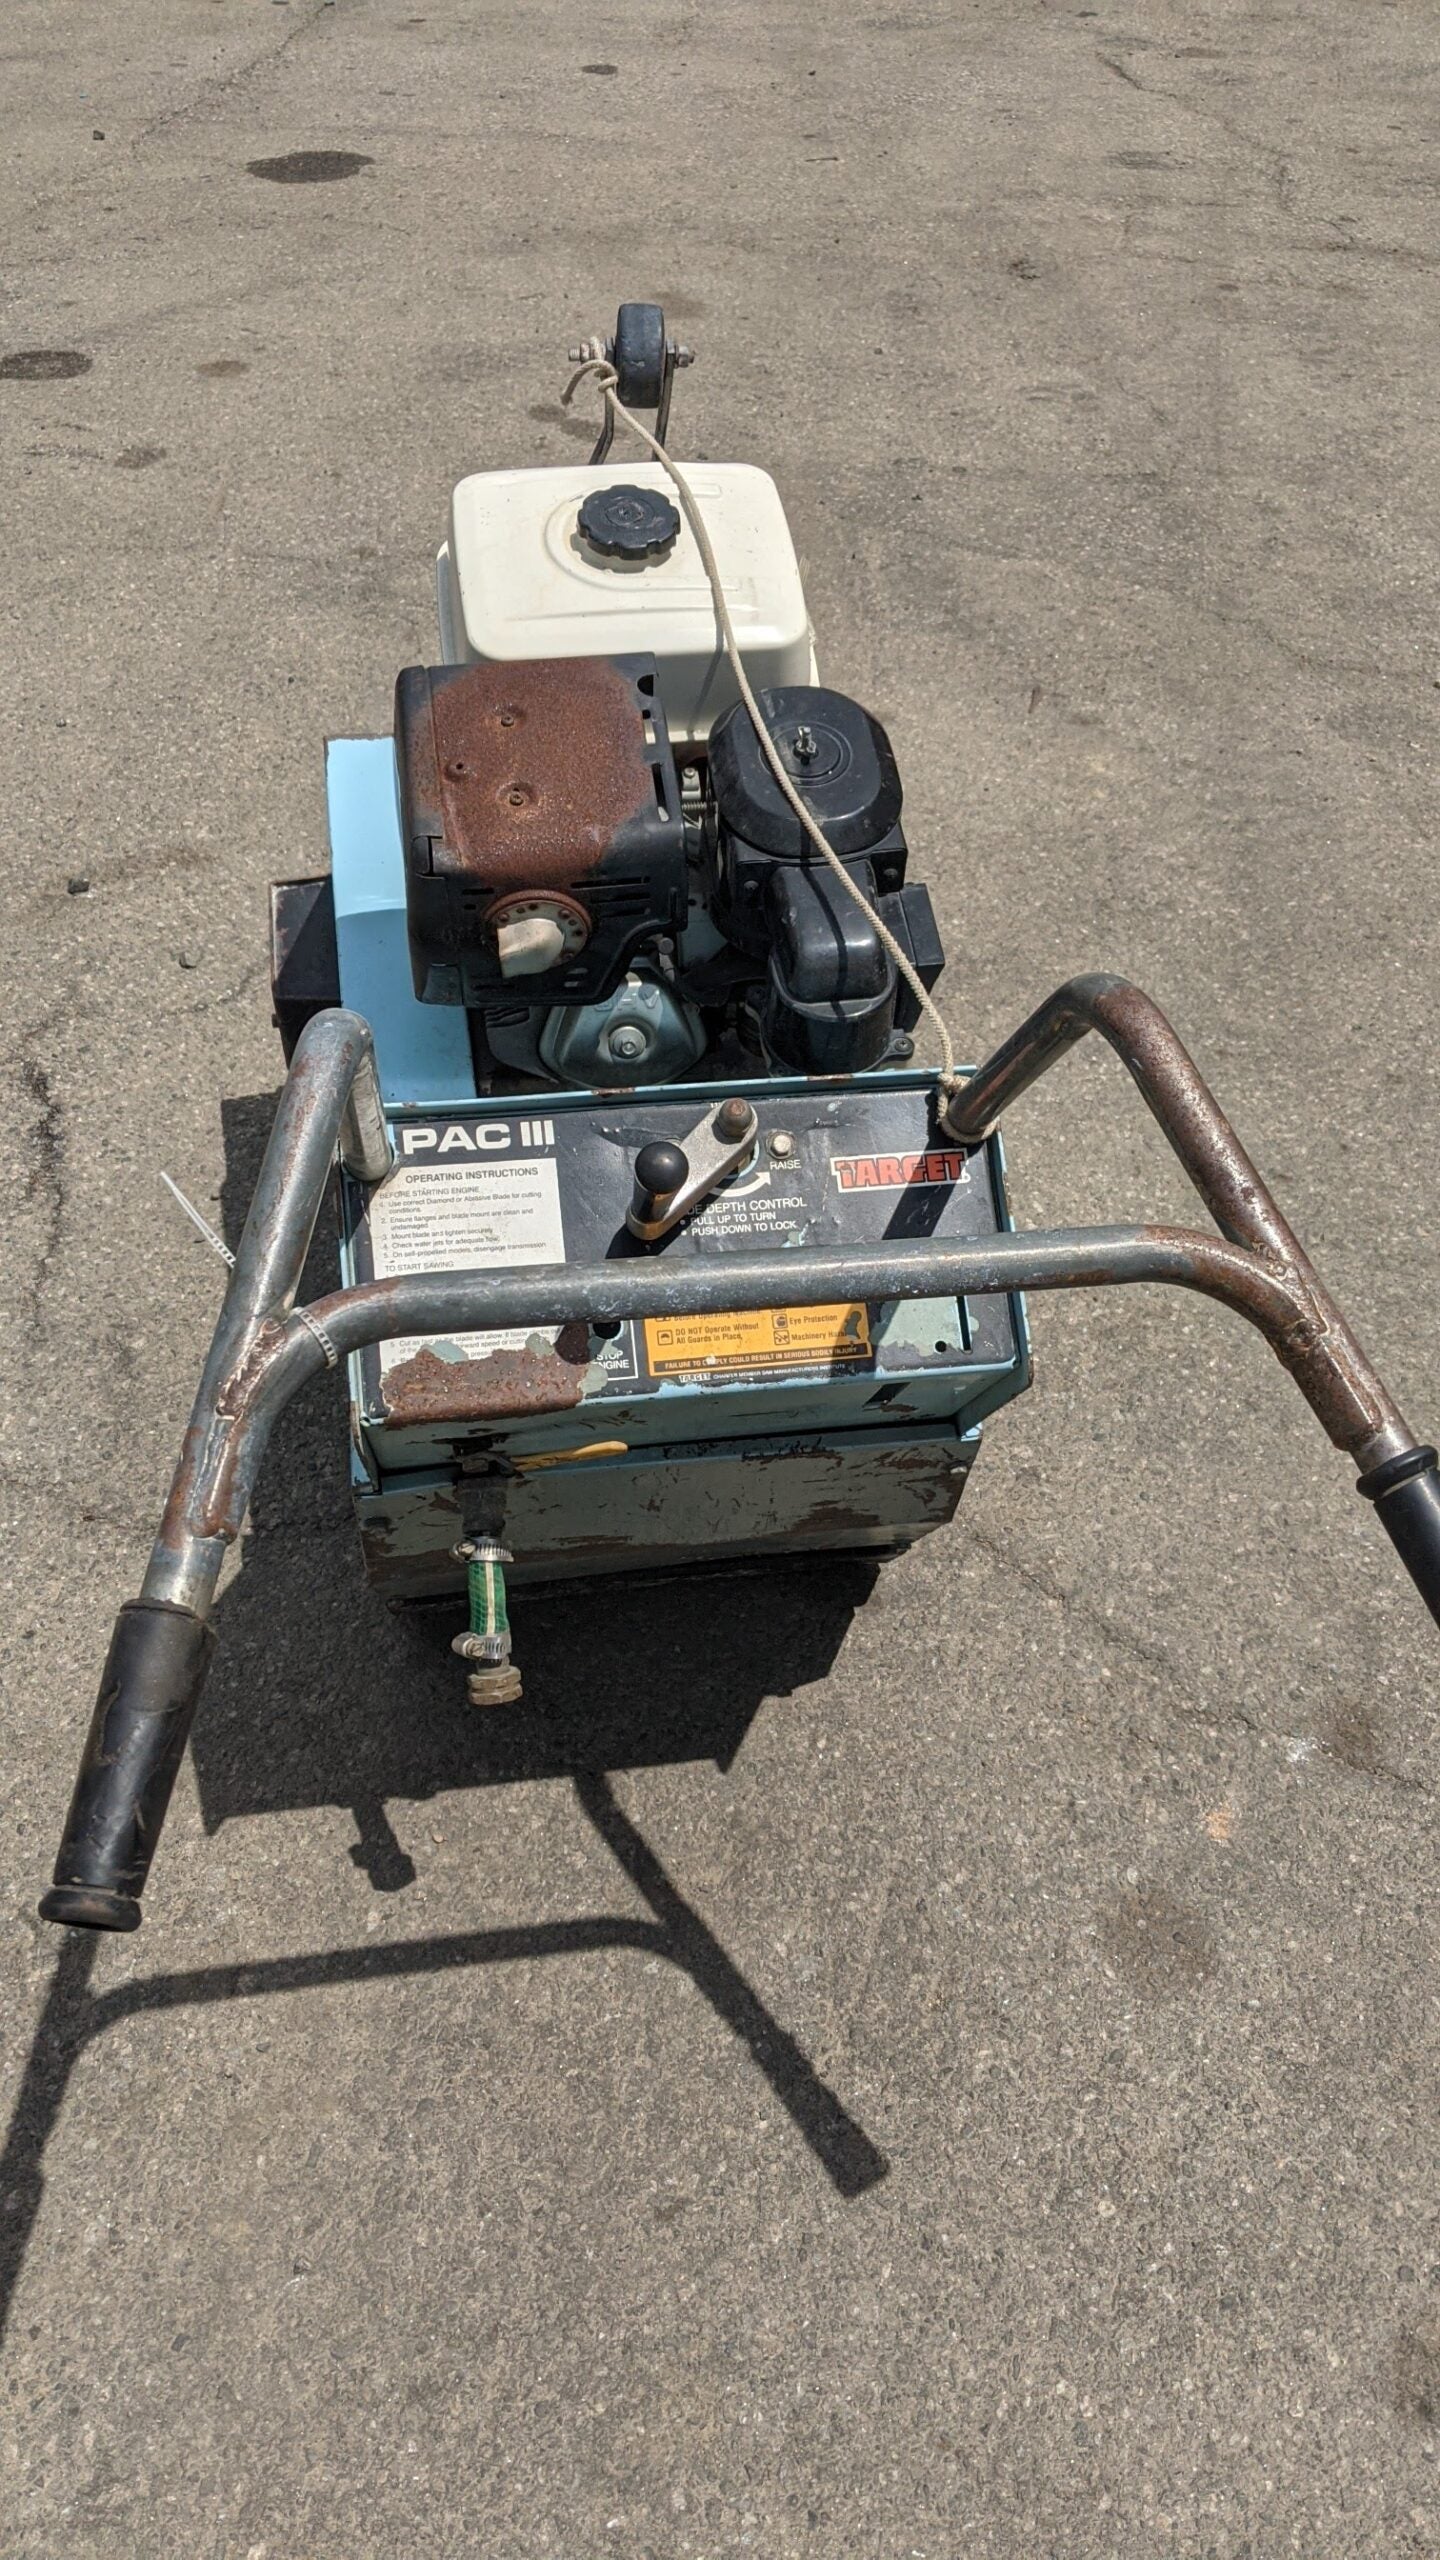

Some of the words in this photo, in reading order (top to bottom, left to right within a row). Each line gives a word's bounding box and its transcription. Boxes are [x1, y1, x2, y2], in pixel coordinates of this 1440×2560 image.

[402, 1123, 511, 1155] PAC
[519, 1120, 555, 1147] III
[770, 1160, 801, 1170] RAISE
[836, 1152, 964, 1188] TARGET
[405, 1170, 463, 1184] OPERATING
[465, 1167, 539, 1180] INSTRUCTIONS
[380, 1190, 410, 1199] BEFORE
[412, 1188, 449, 1197] STARTING
[451, 1186, 480, 1194] ENGINE
[706, 1201, 746, 1214] DEPTH
[749, 1197, 807, 1211] CONTROL
[691, 1216, 716, 1225] PULL
[717, 1215, 731, 1224] UP
[734, 1214, 747, 1222] TO
[750, 1212, 776, 1221] TURN
[692, 1227, 719, 1236] PUSH
[721, 1224, 752, 1234] DOWN
[754, 1222, 767, 1232] TO
[771, 1220, 797, 1230] LOCK
[433, 1240, 444, 1248] jets
[455, 1237, 484, 1245] adequate
[473, 1245, 506, 1253] disengage
[397, 1263, 421, 1271] START
[423, 1260, 455, 1269] SAWING
[789, 1317, 801, 1325] Eye
[804, 1315, 838, 1323] Protection
[688, 1327, 702, 1335] NOT
[704, 1324, 731, 1334] Operate
[733, 1322, 759, 1331] Without
[688, 1335, 712, 1344] Guards
[791, 1332, 826, 1341] Machinery
[480, 1340, 500, 1348] speed
[597, 1351, 623, 1361] STOP
[664, 1361, 691, 1369] FAILURE
[729, 1355, 750, 1363] COULD
[751, 1353, 774, 1361] RESULT
[783, 1350, 810, 1358] SERIOUS
[811, 1348, 833, 1356] BODILY
[592, 1360, 630, 1369] NGINE
